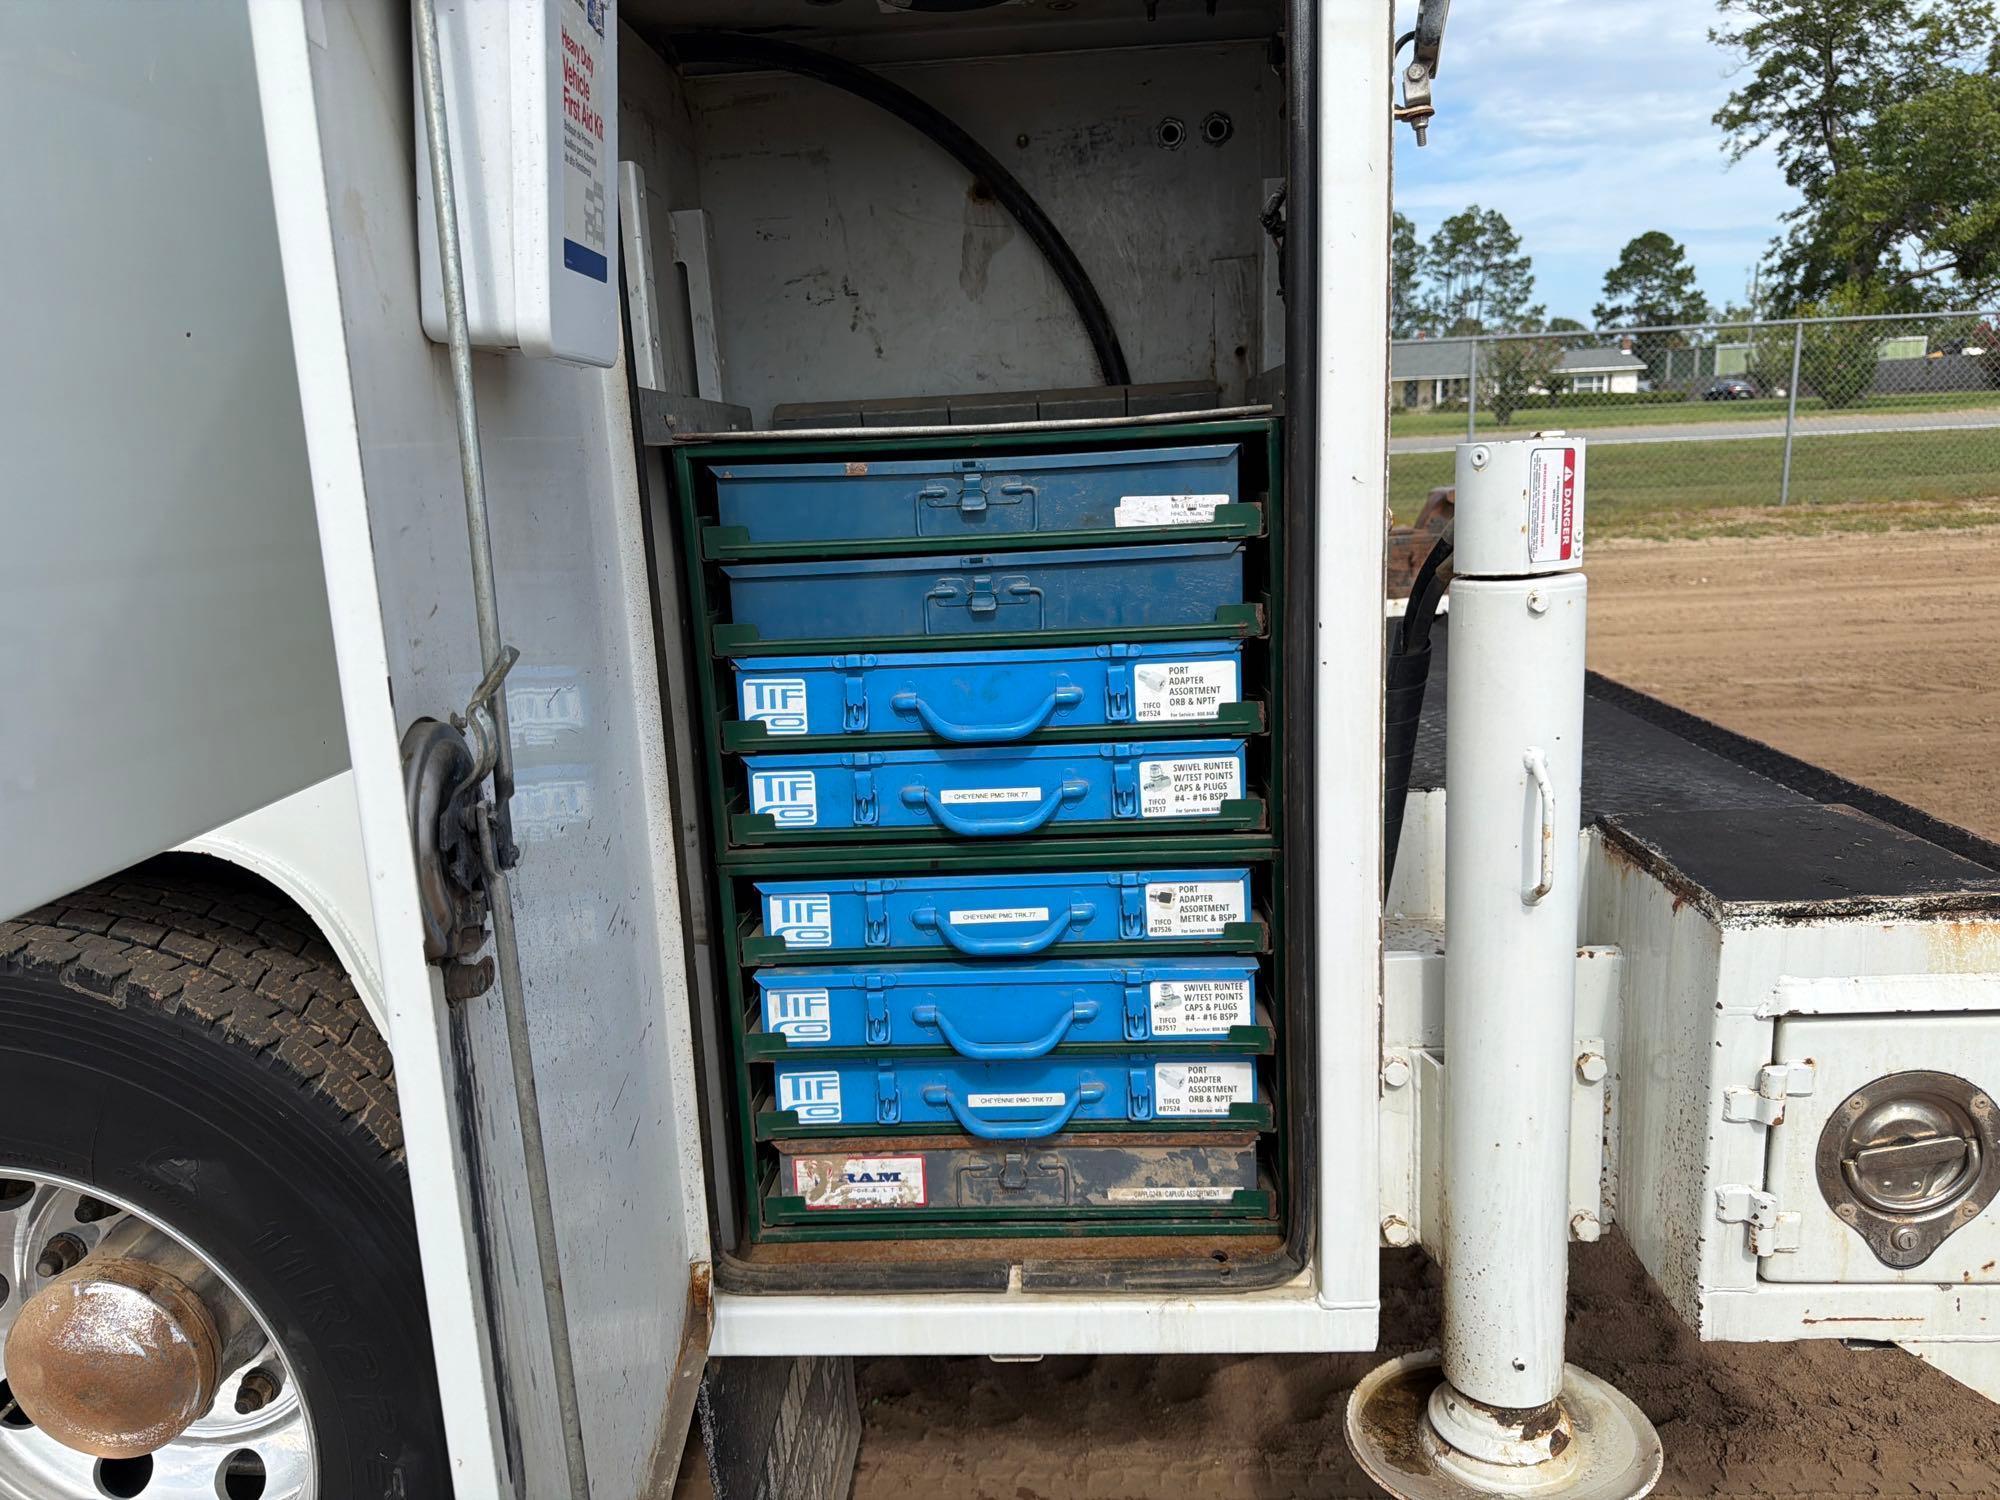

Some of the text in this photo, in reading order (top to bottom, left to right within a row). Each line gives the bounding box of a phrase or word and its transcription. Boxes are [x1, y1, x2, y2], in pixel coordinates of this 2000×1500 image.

[561, 24, 594, 78] Heavy Duty
[562, 53, 590, 101] Vehicle
[564, 85, 604, 142] First Aid Kit
[1562, 488, 1571, 544] DANGER
[1169, 666, 1189, 675] PORT
[1169, 676, 1204, 685] ADAPTER
[1169, 686, 1221, 696] ASSORTMENT
[1173, 774, 1201, 782] W/TEST
[1179, 895, 1213, 903] ADAPTER
[1180, 904, 1230, 913] ASSORTMENT
